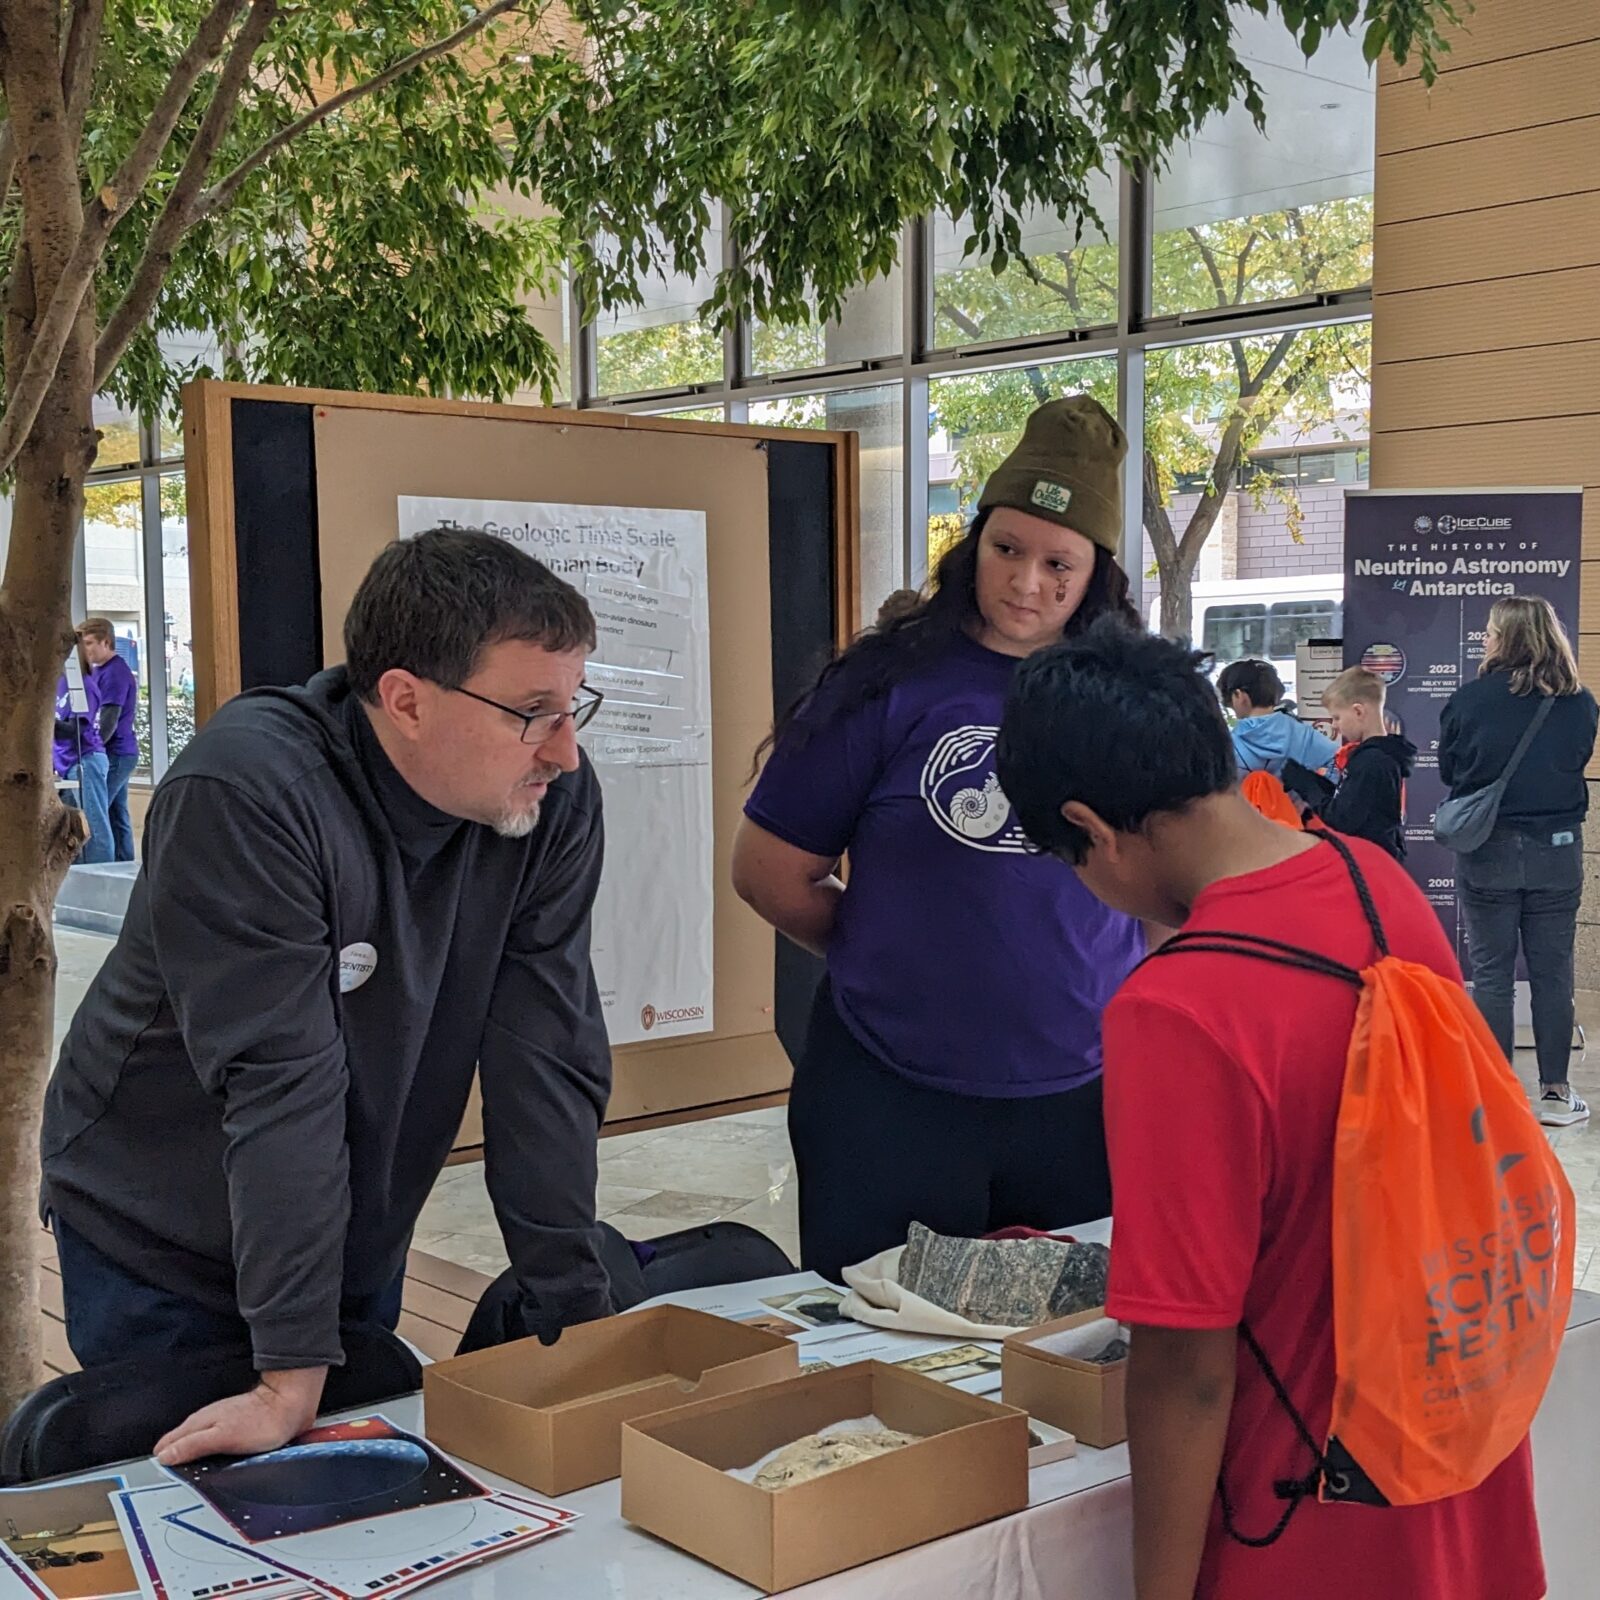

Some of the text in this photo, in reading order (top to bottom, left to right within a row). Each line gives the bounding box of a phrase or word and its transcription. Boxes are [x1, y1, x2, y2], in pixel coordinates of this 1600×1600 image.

[482, 521, 571, 547] Geologic
[575, 525, 622, 546] Time
[627, 527, 676, 547] Scale
[1388, 541, 1539, 552] THE HISTORY OF
[596, 556, 644, 578] Body
[1355, 557, 1571, 578] Neutrino Astronomy
[1410, 579, 1515, 597] Antarctica
[598, 585, 612, 594] Last
[623, 591, 637, 601] Age
[638, 593, 659, 605] Begins
[627, 616, 658, 629] dinosaurs
[1467, 632, 1487, 641] 202
[1429, 664, 1457, 674] 2023
[628, 711, 647, 721] under
[615, 723, 638, 733] tropical
[1428, 879, 1455, 888] 2001
[656, 1006, 705, 1022] WISCONSIN
